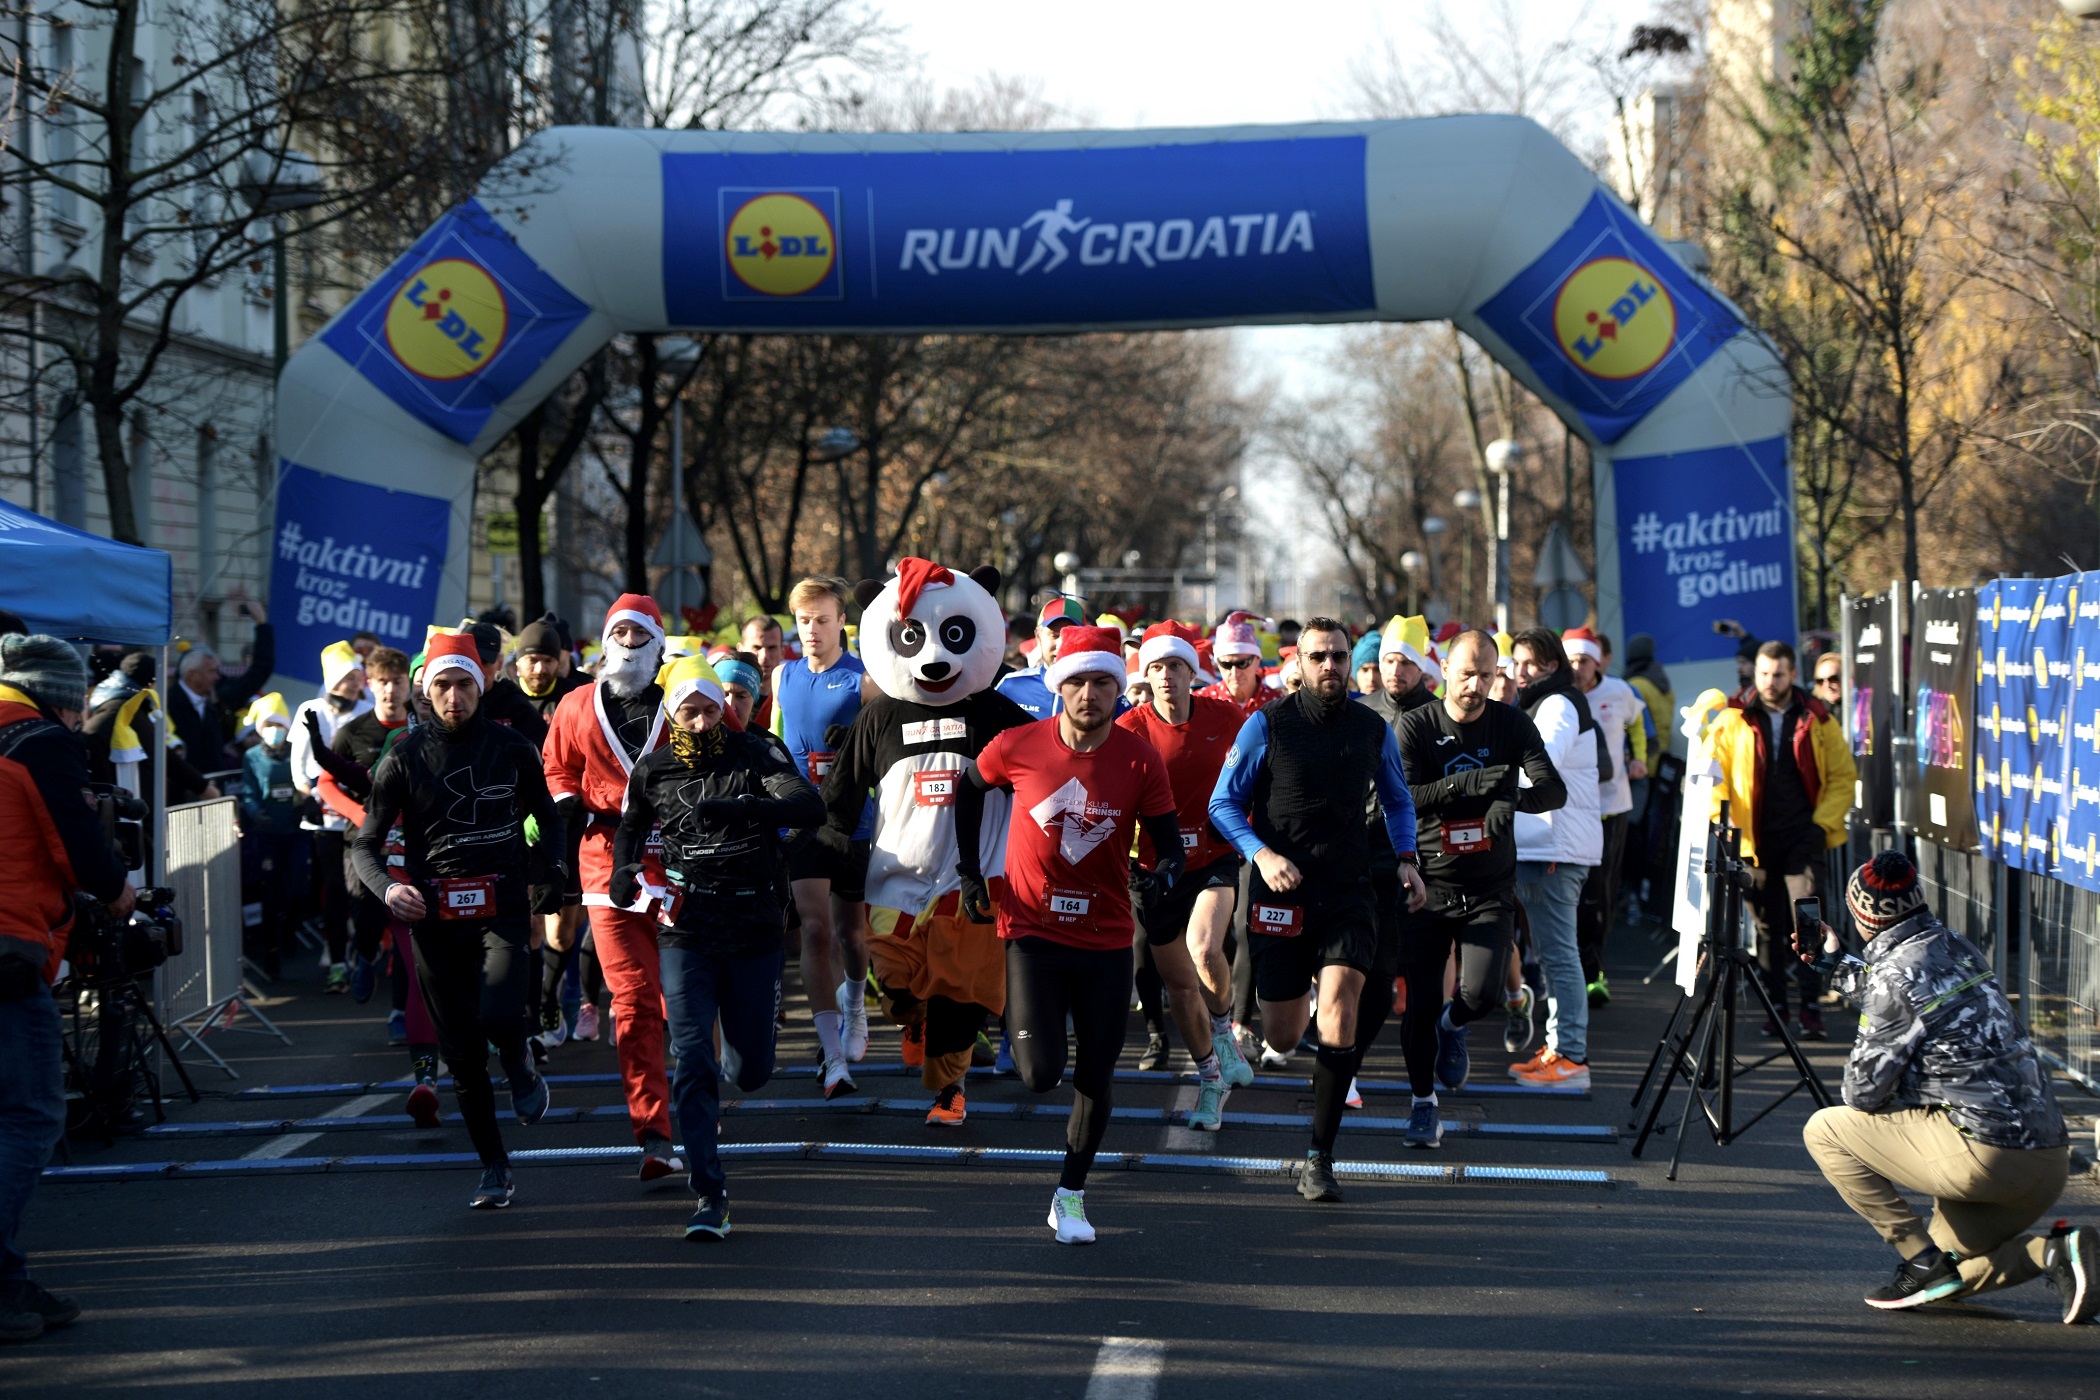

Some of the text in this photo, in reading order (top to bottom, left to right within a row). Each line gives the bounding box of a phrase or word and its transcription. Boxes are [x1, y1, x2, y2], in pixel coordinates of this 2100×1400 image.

[734, 225, 828, 262] LIDL
[901, 210, 1316, 275] RUN CROATIA
[404, 278, 485, 362] LIDL
[1572, 279, 1657, 362] LIDL
[1631, 501, 1782, 554] #aktivni
[278, 520, 429, 589] #aktivni
[1666, 549, 1726, 575] kroz
[294, 567, 350, 600] kroz
[1677, 561, 1783, 607] godinu
[296, 596, 413, 639] godinu
[1017, 703, 1040, 713] ELME
[1477, 748, 1490, 757] 20
[929, 784, 945, 793] 182
[1087, 801, 1109, 809] KLUB
[1085, 808, 1122, 817] ZRINSKI
[483, 829, 512, 840] ARMOUR
[1463, 832, 1469, 841] 2
[715, 843, 748, 853] ARMOUR
[457, 893, 477, 905] 267
[1060, 900, 1080, 912] 164
[1266, 911, 1286, 922] 227
